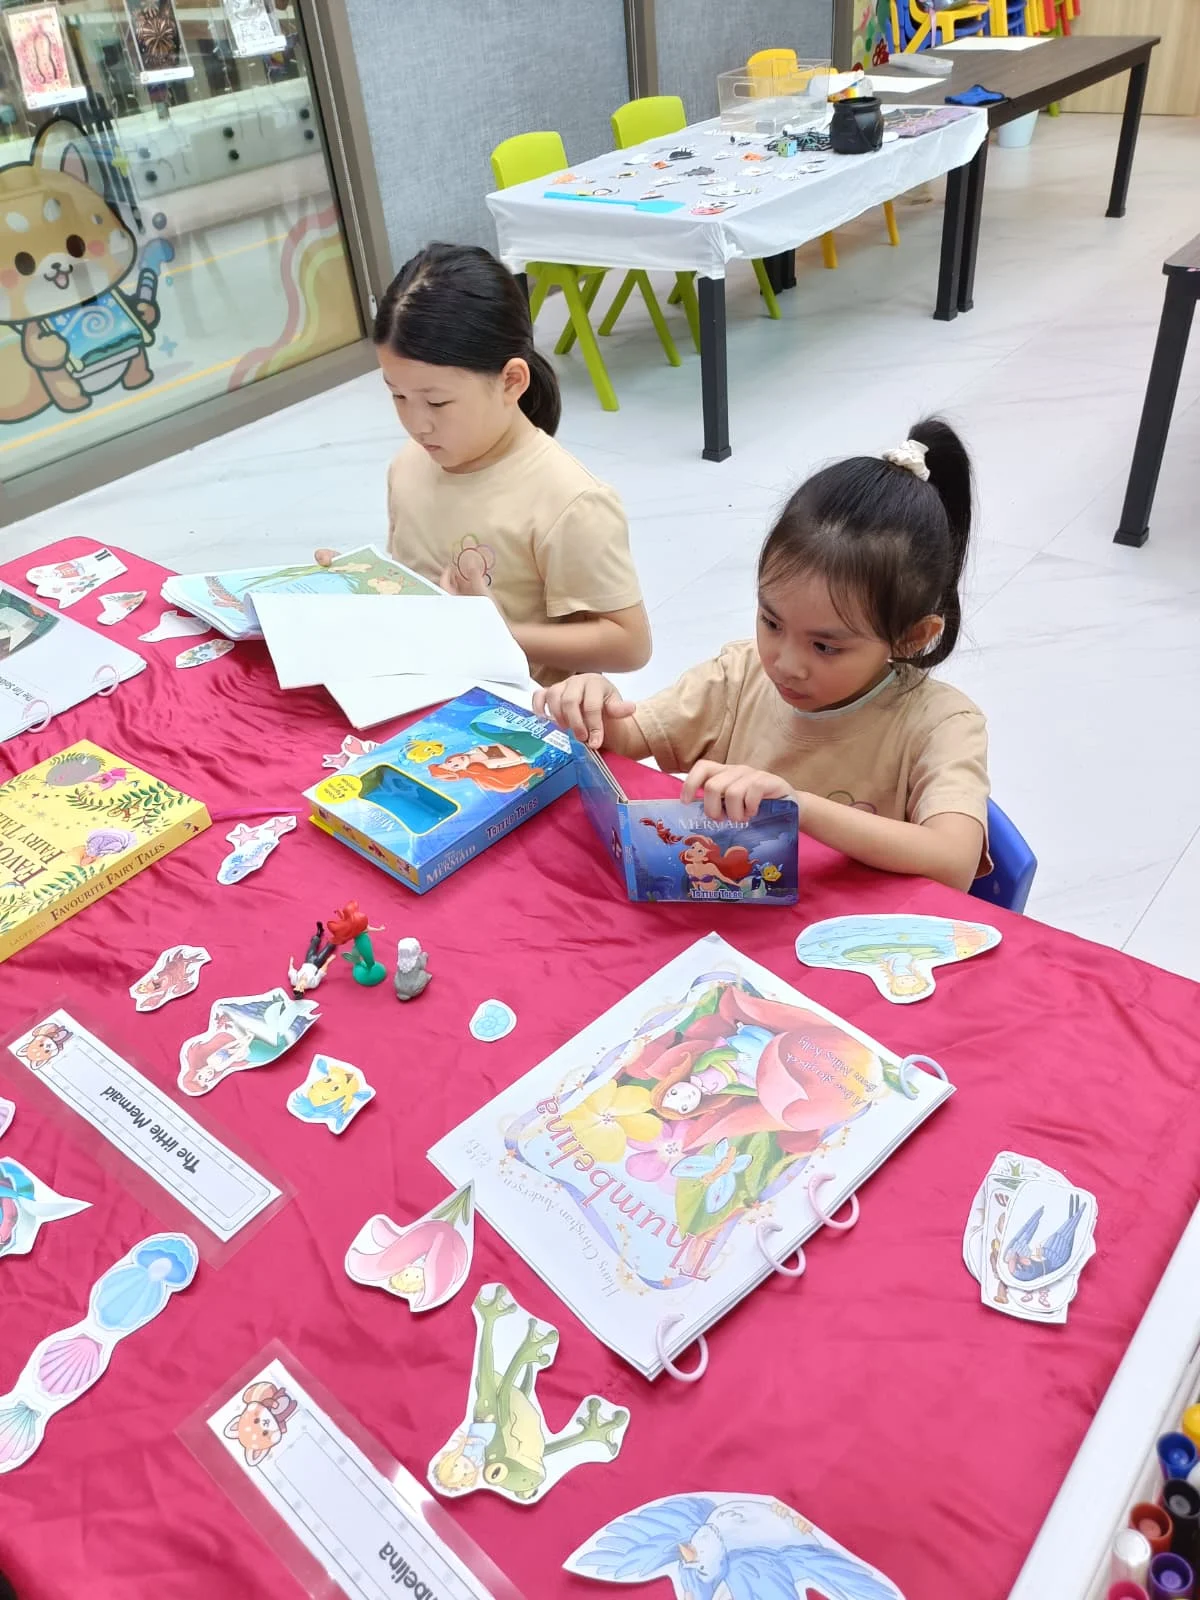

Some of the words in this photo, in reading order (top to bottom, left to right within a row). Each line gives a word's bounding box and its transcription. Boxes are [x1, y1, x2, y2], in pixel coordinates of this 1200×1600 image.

[0, 841, 48, 887] FAVO
[18, 832, 66, 865] FAIRY
[425, 845, 476, 884] MERMAID
[50, 883, 106, 921] FAVOURITE
[105, 862, 135, 886] FAIRY
[134, 843, 166, 866] TALES
[799, 1035, 823, 1057] Kelly
[100, 1085, 152, 1128] Mermaid
[149, 1124, 179, 1153] little
[177, 1148, 200, 1174] The
[503, 1177, 557, 1213] Andersen
[536, 1095, 716, 1282] Thumbelina
[558, 1209, 599, 1261] Christian
[597, 1260, 621, 1298] Hans
